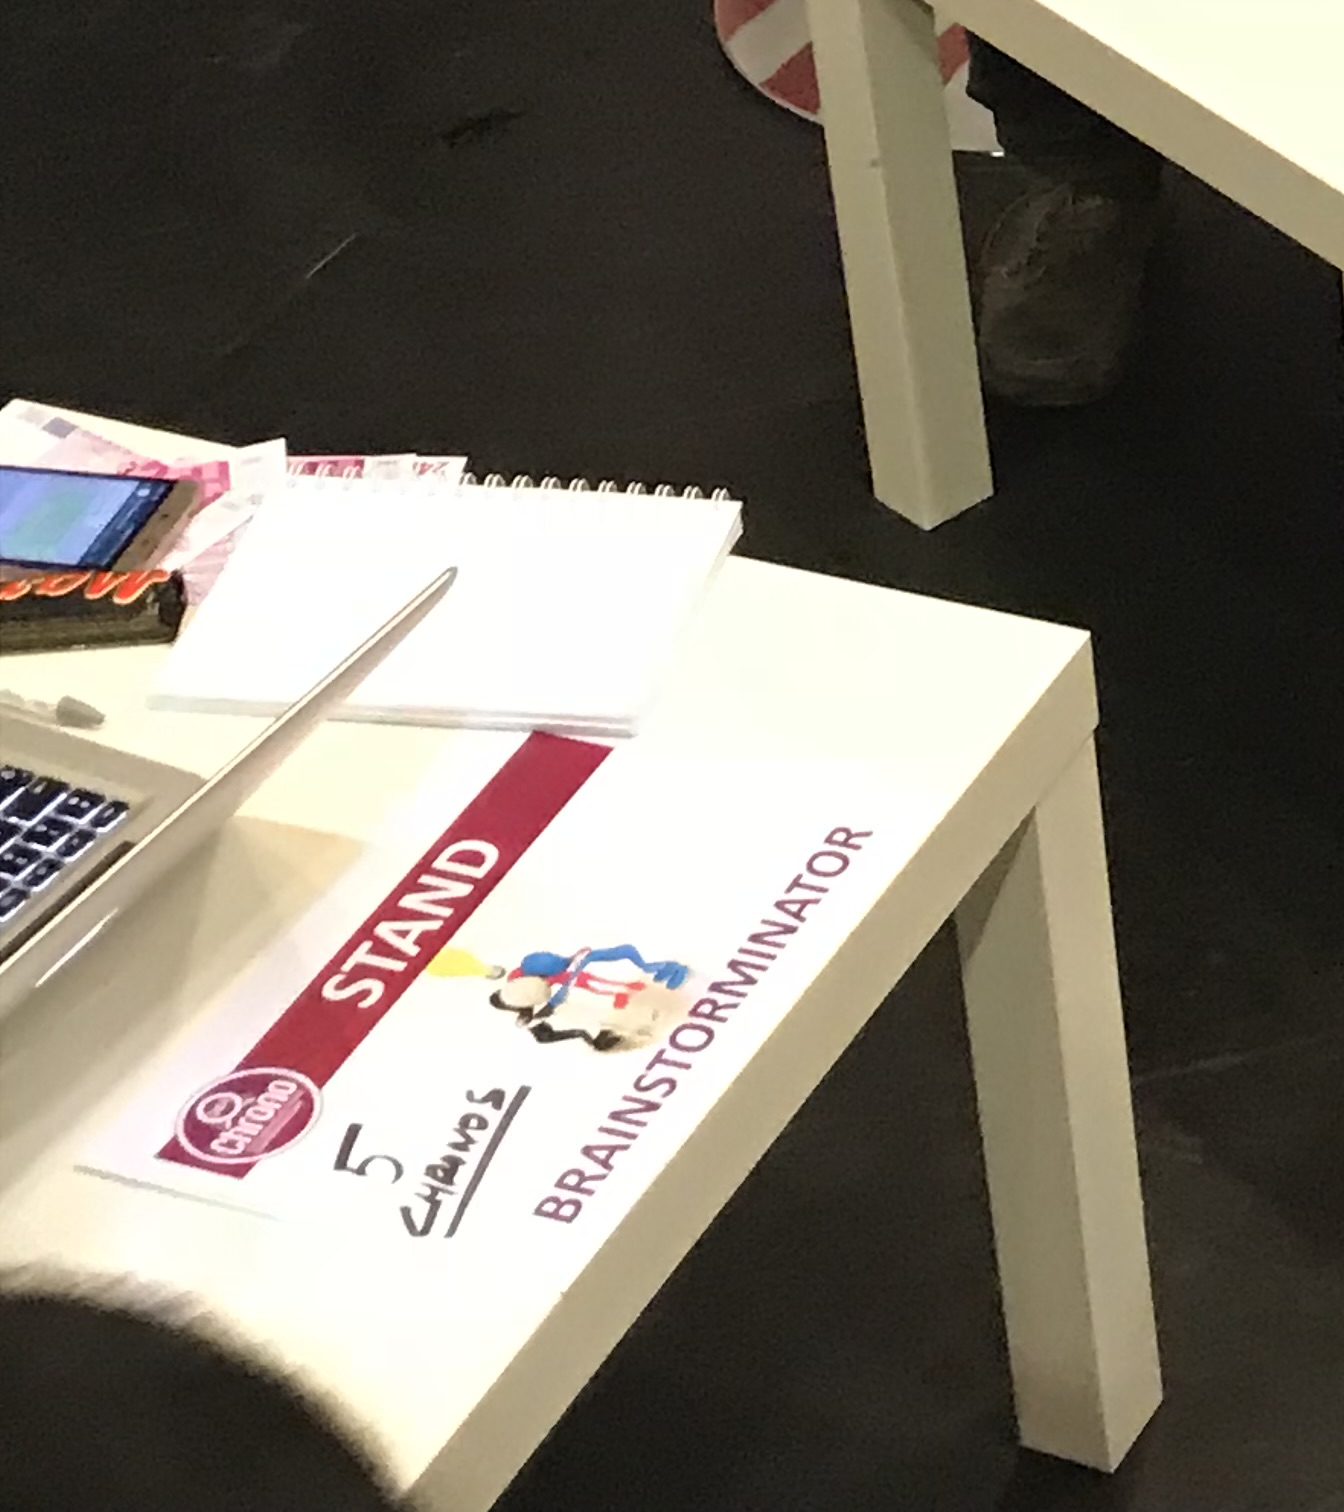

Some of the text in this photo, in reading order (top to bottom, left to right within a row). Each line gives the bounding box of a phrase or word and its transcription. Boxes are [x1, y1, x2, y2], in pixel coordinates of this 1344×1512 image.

[321, 837, 501, 1010] STAND
[534, 824, 874, 1225] BRAINSTORMINATOR
[333, 1122, 405, 1185] 5
